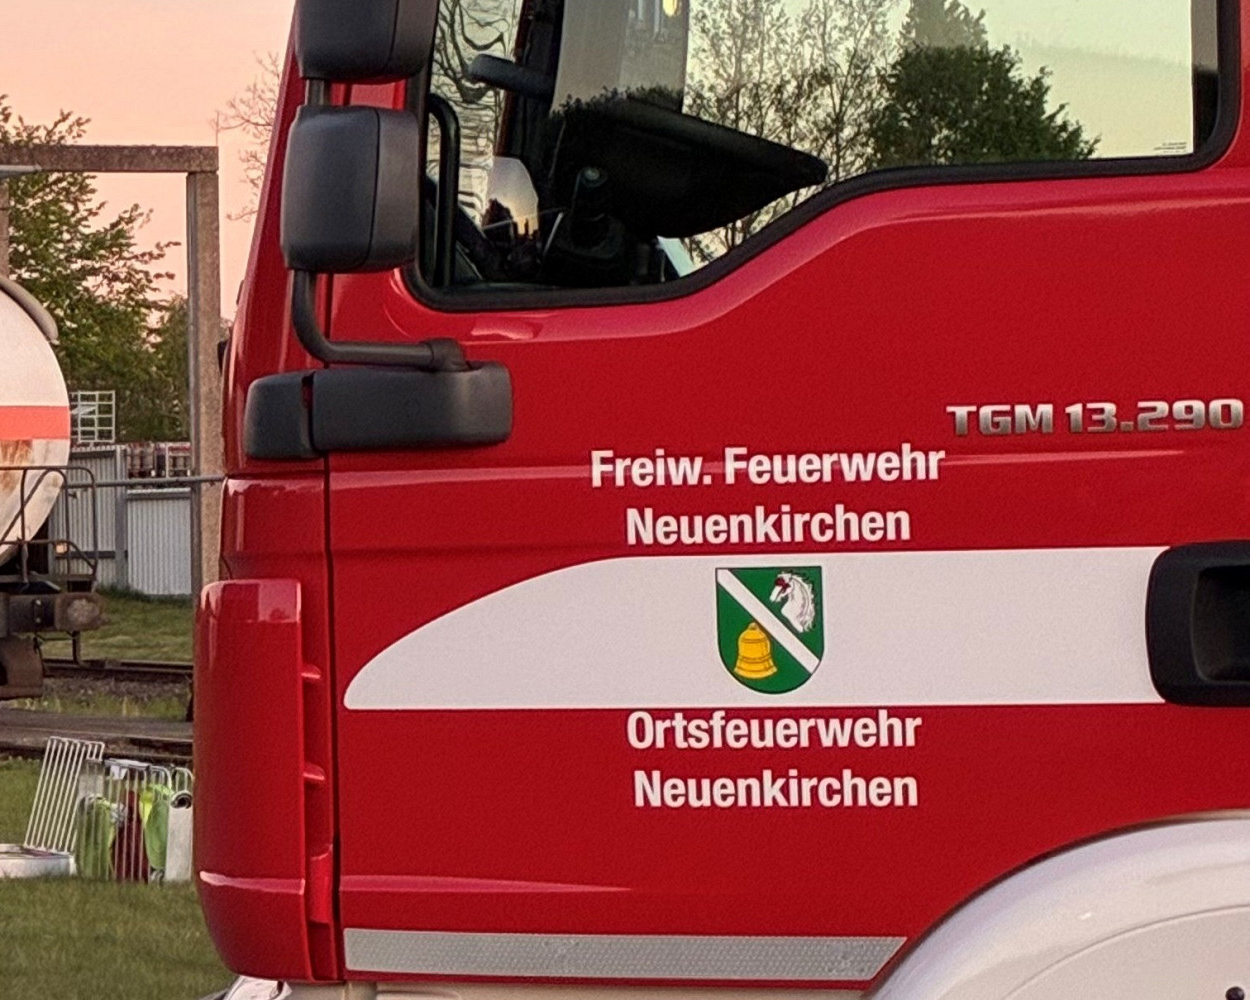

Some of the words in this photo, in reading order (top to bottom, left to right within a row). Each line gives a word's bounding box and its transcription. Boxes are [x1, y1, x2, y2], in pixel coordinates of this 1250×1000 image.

[945, 402, 1054, 437] TGM
[1064, 397, 1245, 434] 13.290
[591, 448, 713, 488] Freiw.
[724, 442, 946, 486] Feuerwehr
[626, 503, 911, 546] Neuenkirchen
[627, 709, 923, 750] Ortsfeuerwehr
[634, 768, 918, 808] Neuenkirchen
